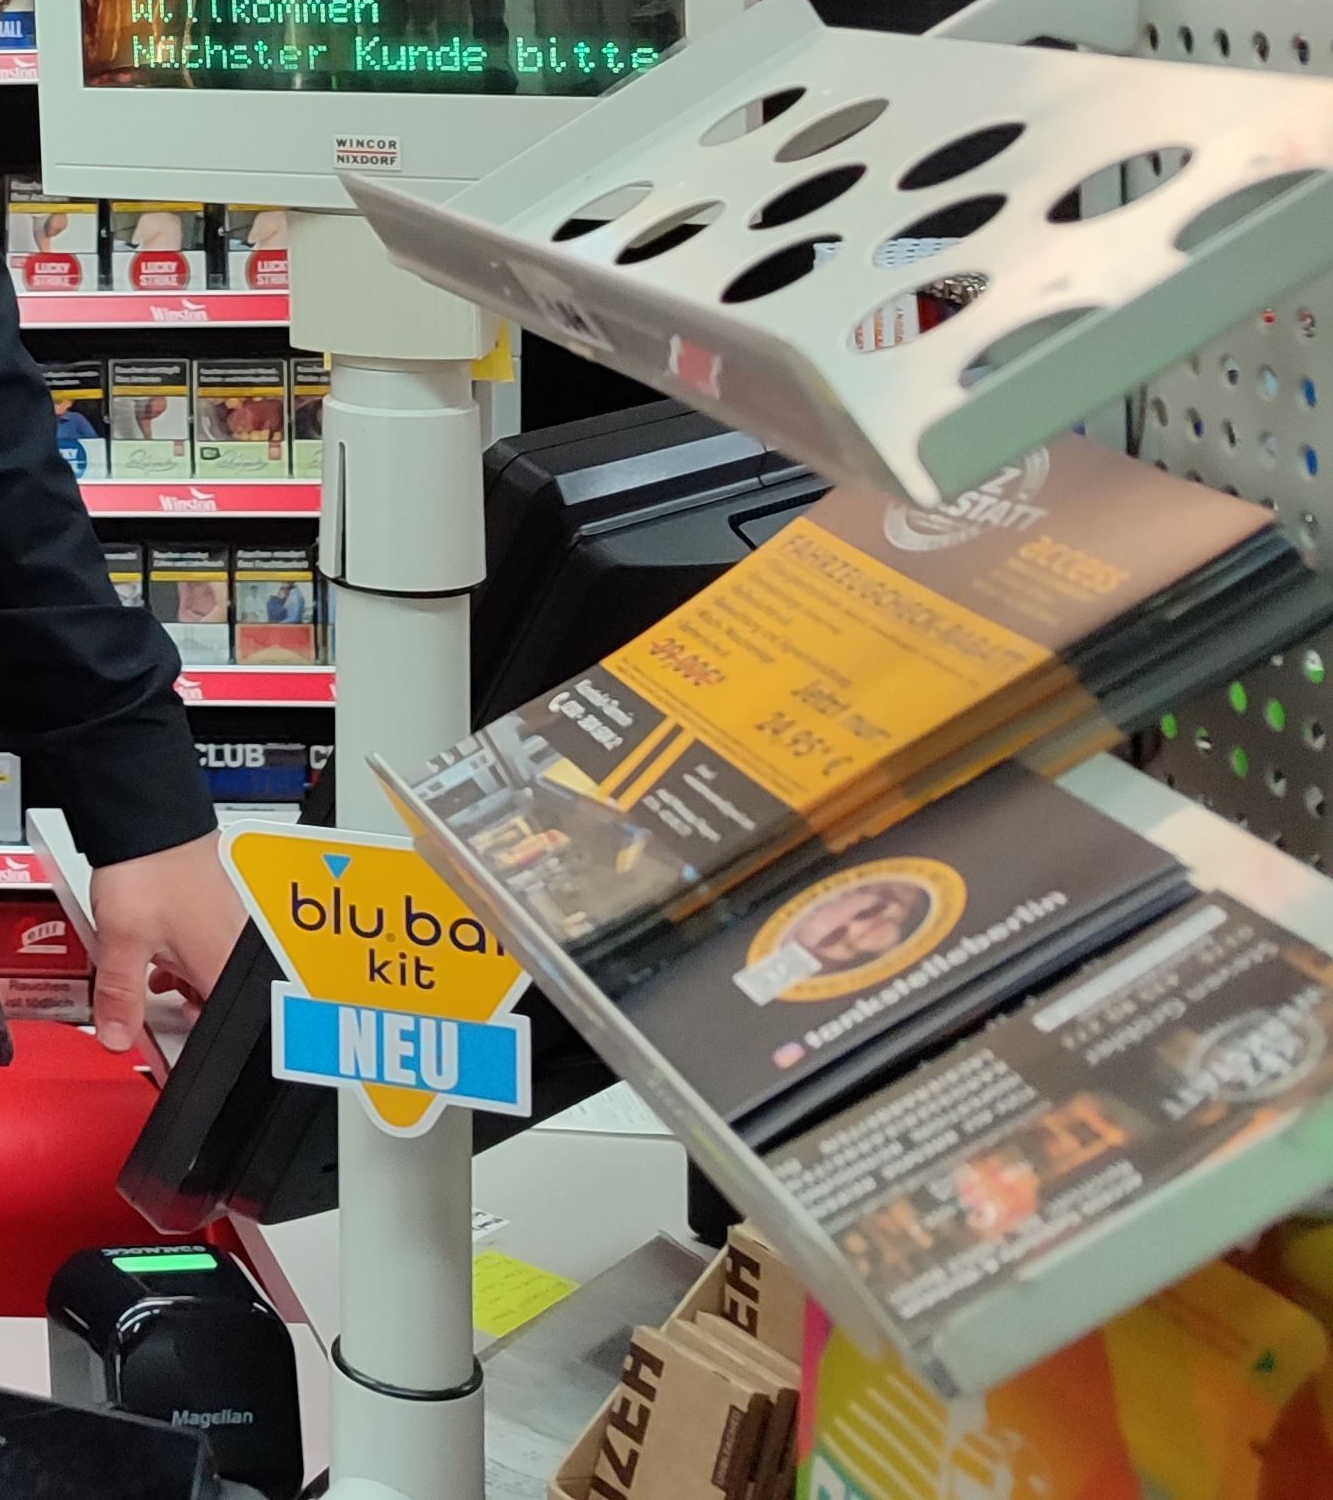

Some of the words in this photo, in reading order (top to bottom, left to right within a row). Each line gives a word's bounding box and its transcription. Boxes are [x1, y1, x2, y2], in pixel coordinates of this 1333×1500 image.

[134, 36, 328, 71] Nächster
[354, 36, 487, 73] Kunde
[517, 37, 659, 75] bitte
[337, 137, 398, 150] WINCOR
[337, 153, 398, 166] NIXDORF
[369, 949, 436, 990] kit
[338, 1006, 460, 1089] NEU
[172, 1407, 253, 1429] Magellan
